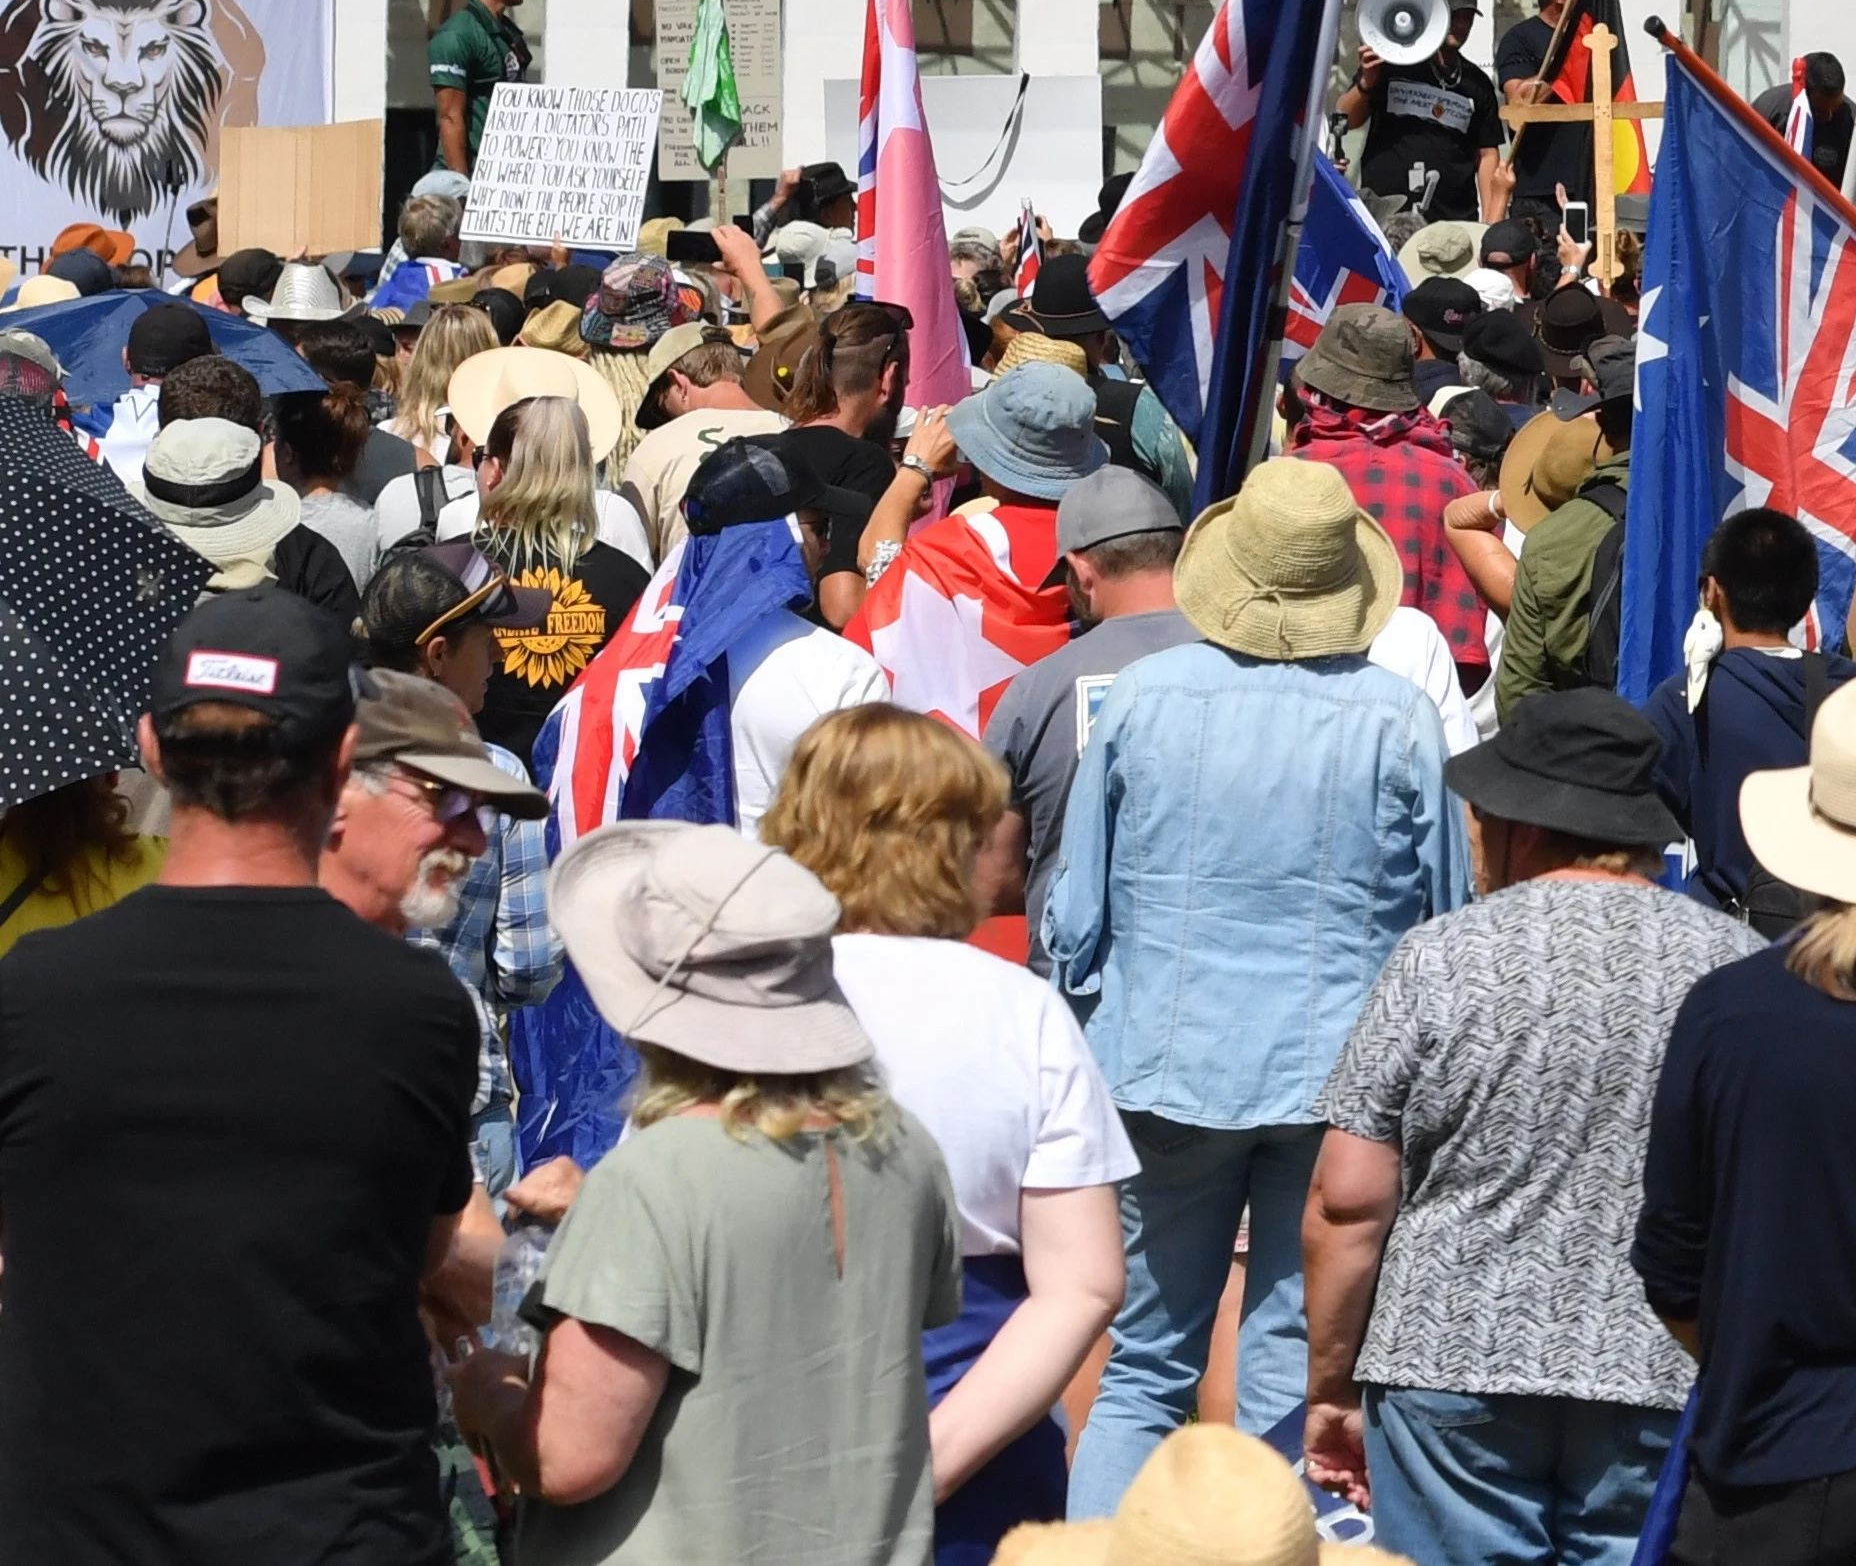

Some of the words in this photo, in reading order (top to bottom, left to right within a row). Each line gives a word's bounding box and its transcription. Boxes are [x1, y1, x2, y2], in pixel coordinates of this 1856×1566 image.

[496, 87, 523, 108] YOU
[526, 87, 565, 111] KNOW
[568, 87, 609, 112] THOSE
[742, 104, 771, 115] ACK
[487, 110, 530, 132] ABOUT
[532, 112, 540, 133] A
[615, 115, 648, 138] PATH
[482, 133, 499, 156] TO
[555, 136, 579, 162] YOU
[581, 139, 619, 165] KNOW
[622, 140, 646, 166] THE
[475, 159, 494, 181] BIT
[541, 163, 567, 188] YOU
[565, 165, 590, 189] ASK
[588, 166, 648, 192] YOURSELF
[470, 185, 498, 207] WHY
[557, 190, 597, 214] PEOPLE
[599, 192, 628, 216] STOP
[509, 211, 536, 236] THE
[536, 212, 559, 237] BIT
[560, 216, 584, 241] WE
[583, 217, 613, 242] ARE
[0, 245, 44, 275] TH
[547, 612, 606, 635] FREEDOM
